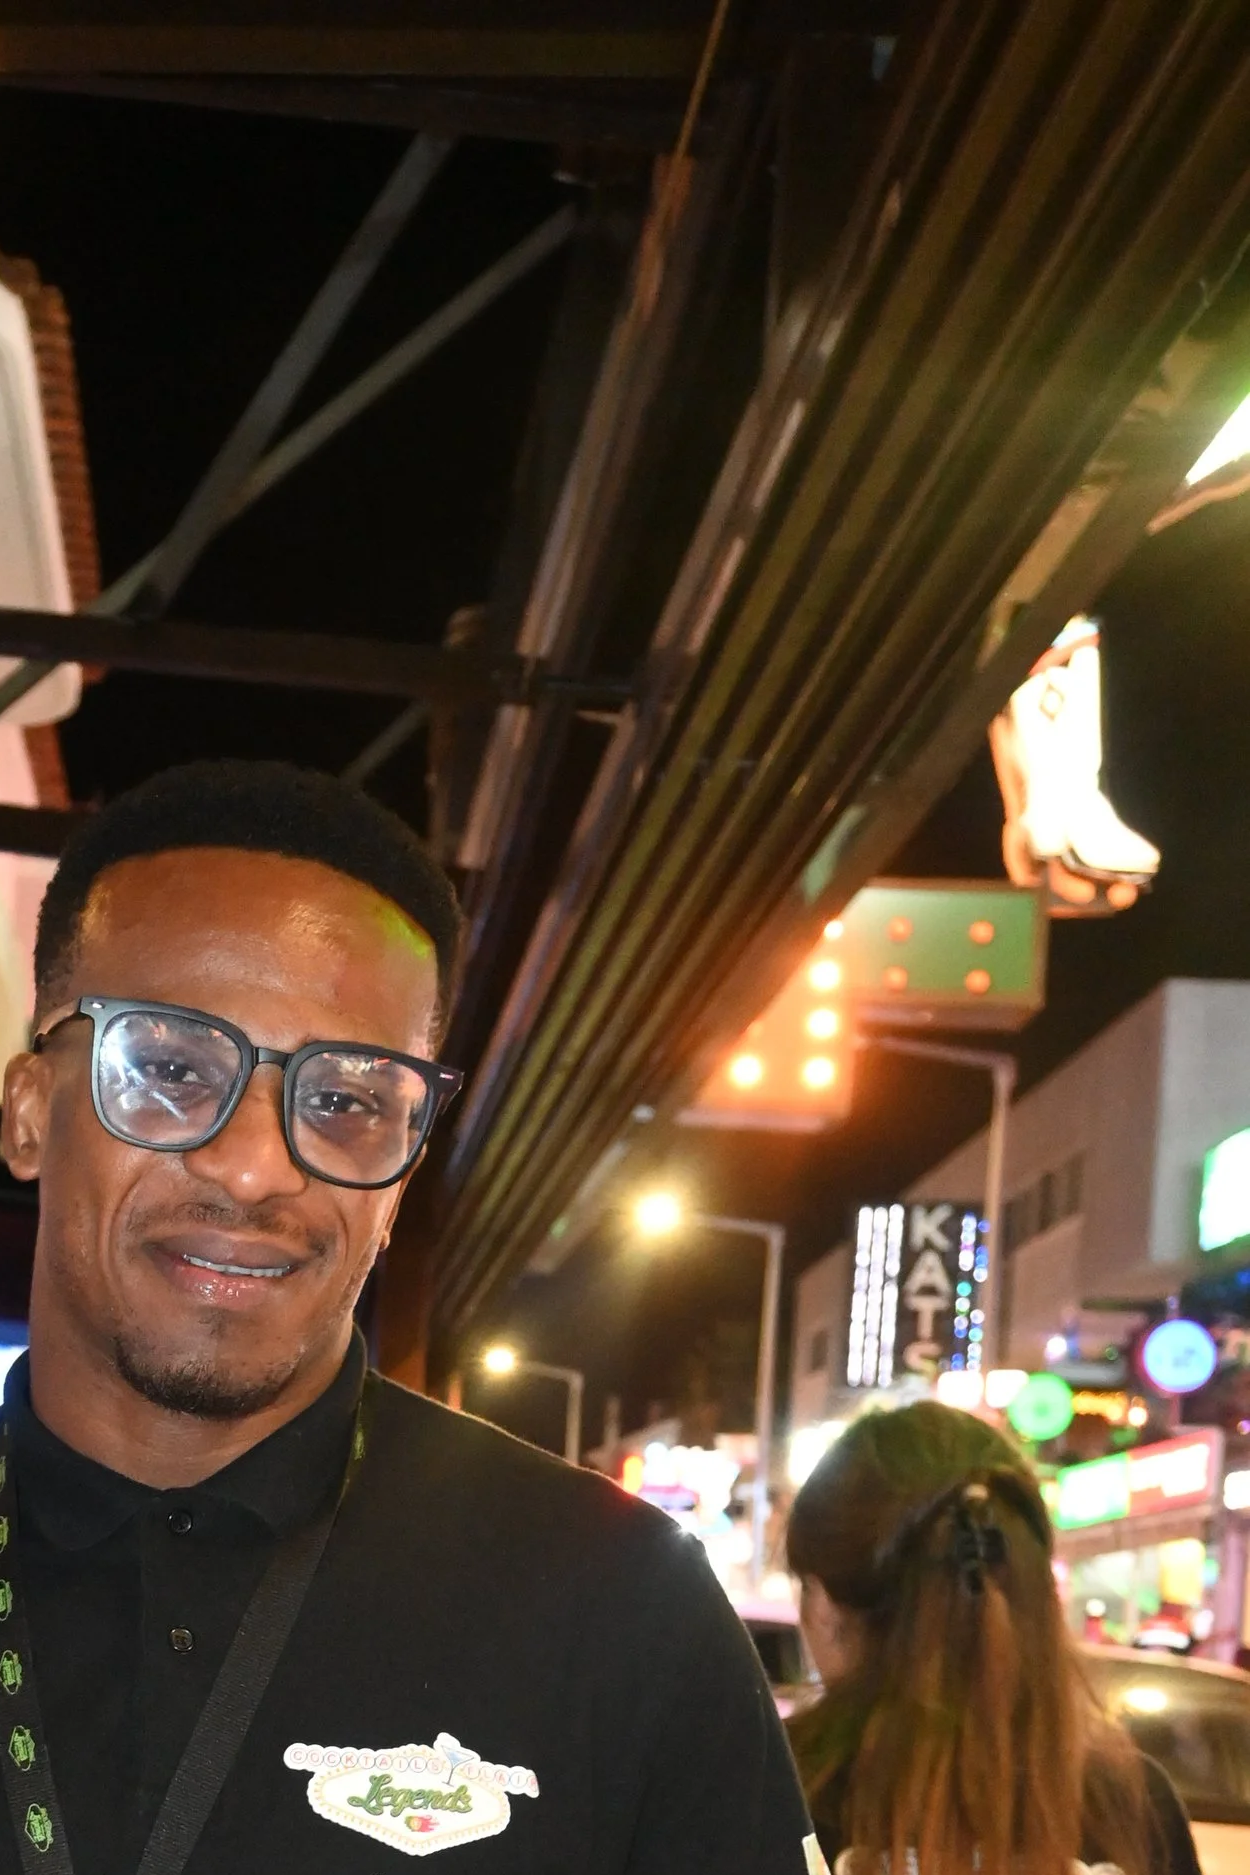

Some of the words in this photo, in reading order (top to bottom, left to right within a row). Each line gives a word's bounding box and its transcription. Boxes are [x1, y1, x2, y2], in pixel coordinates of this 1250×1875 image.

[904, 1204, 953, 1378] KATS
[291, 1748, 442, 1773] COCKTAILS
[347, 1774, 473, 1817] Legends
